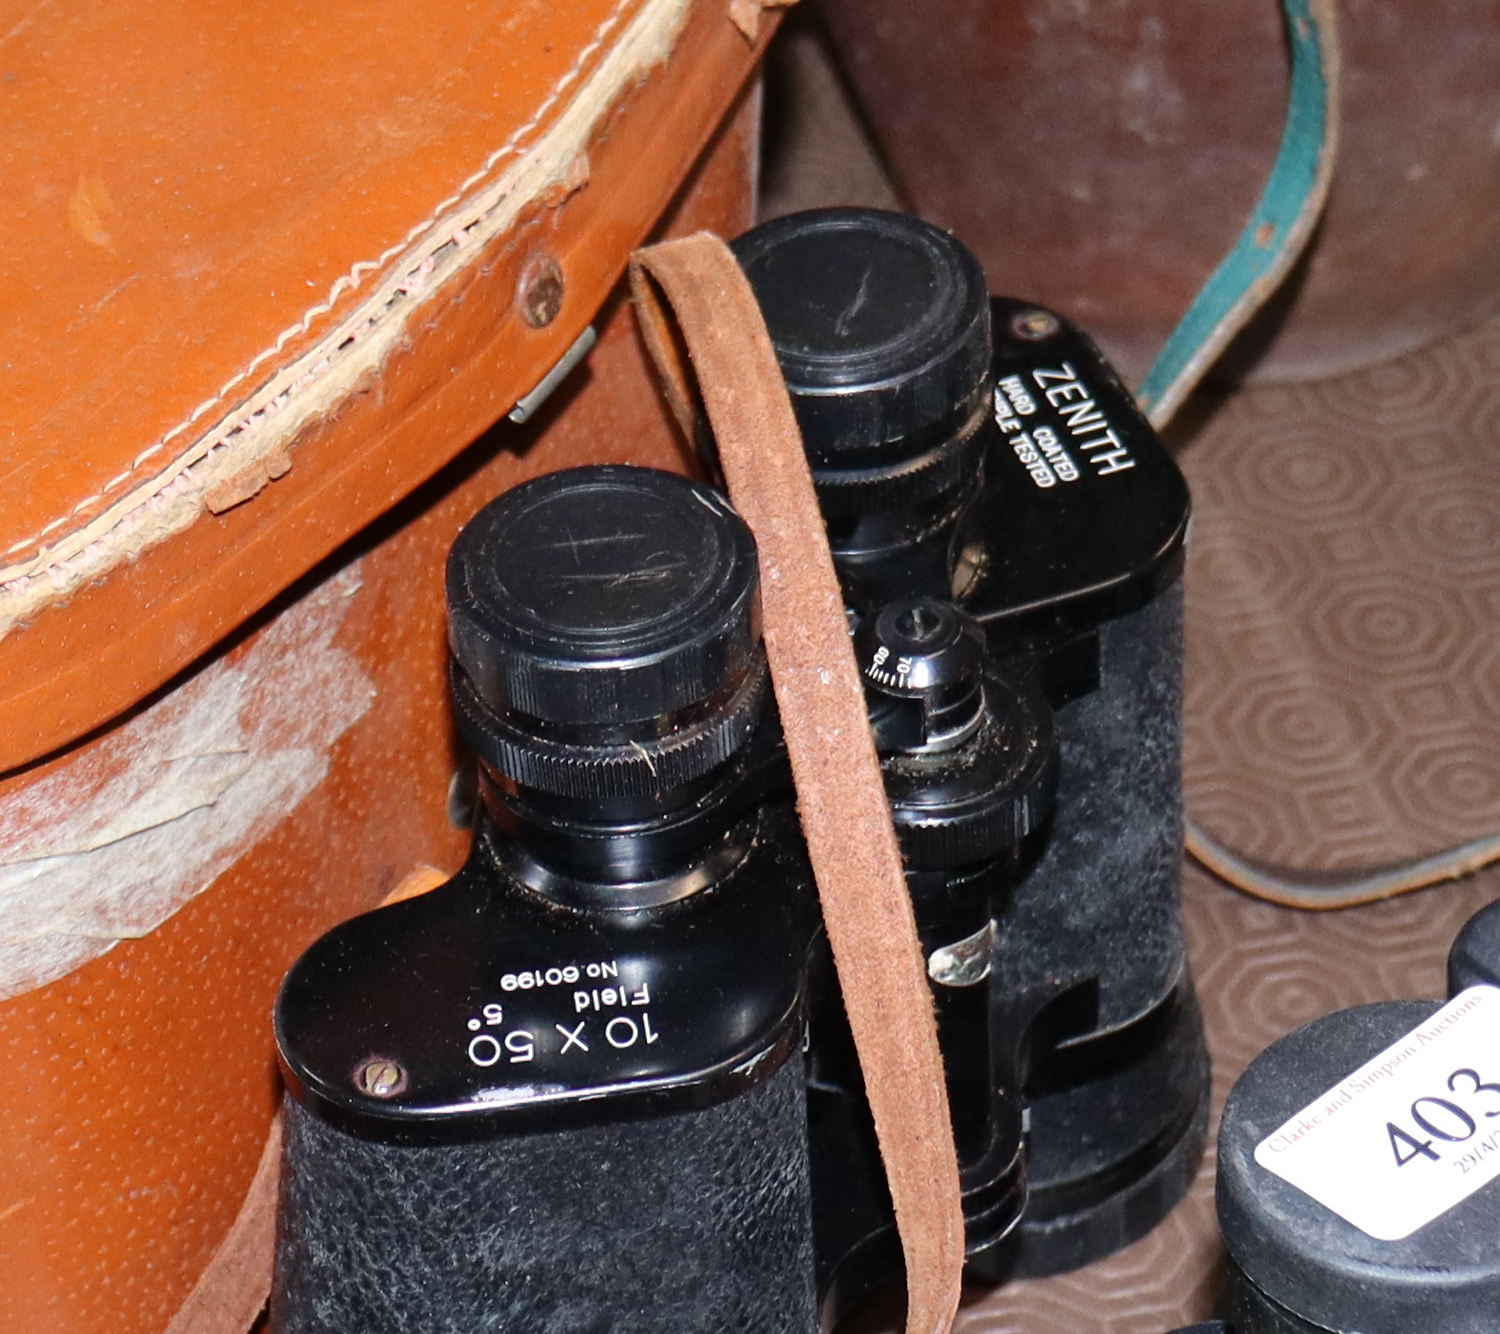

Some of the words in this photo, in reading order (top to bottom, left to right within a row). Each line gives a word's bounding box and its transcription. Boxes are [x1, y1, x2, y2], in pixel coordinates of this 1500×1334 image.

[998, 374, 1037, 416] HARD
[1032, 426, 1079, 482] COATED
[1032, 362, 1136, 476] ZENITH
[1009, 432, 1056, 488] TESTED
[873, 646, 890, 665] 60
[897, 657, 912, 674] 70
[574, 982, 650, 1013] Field
[468, 1030, 534, 1067] 50
[605, 1012, 659, 1048] 10
[1268, 1110, 1323, 1153] Clarke
[1324, 1089, 1353, 1117] and
[1349, 1044, 1417, 1094] Simpson
[1415, 993, 1483, 1047] Auctions
